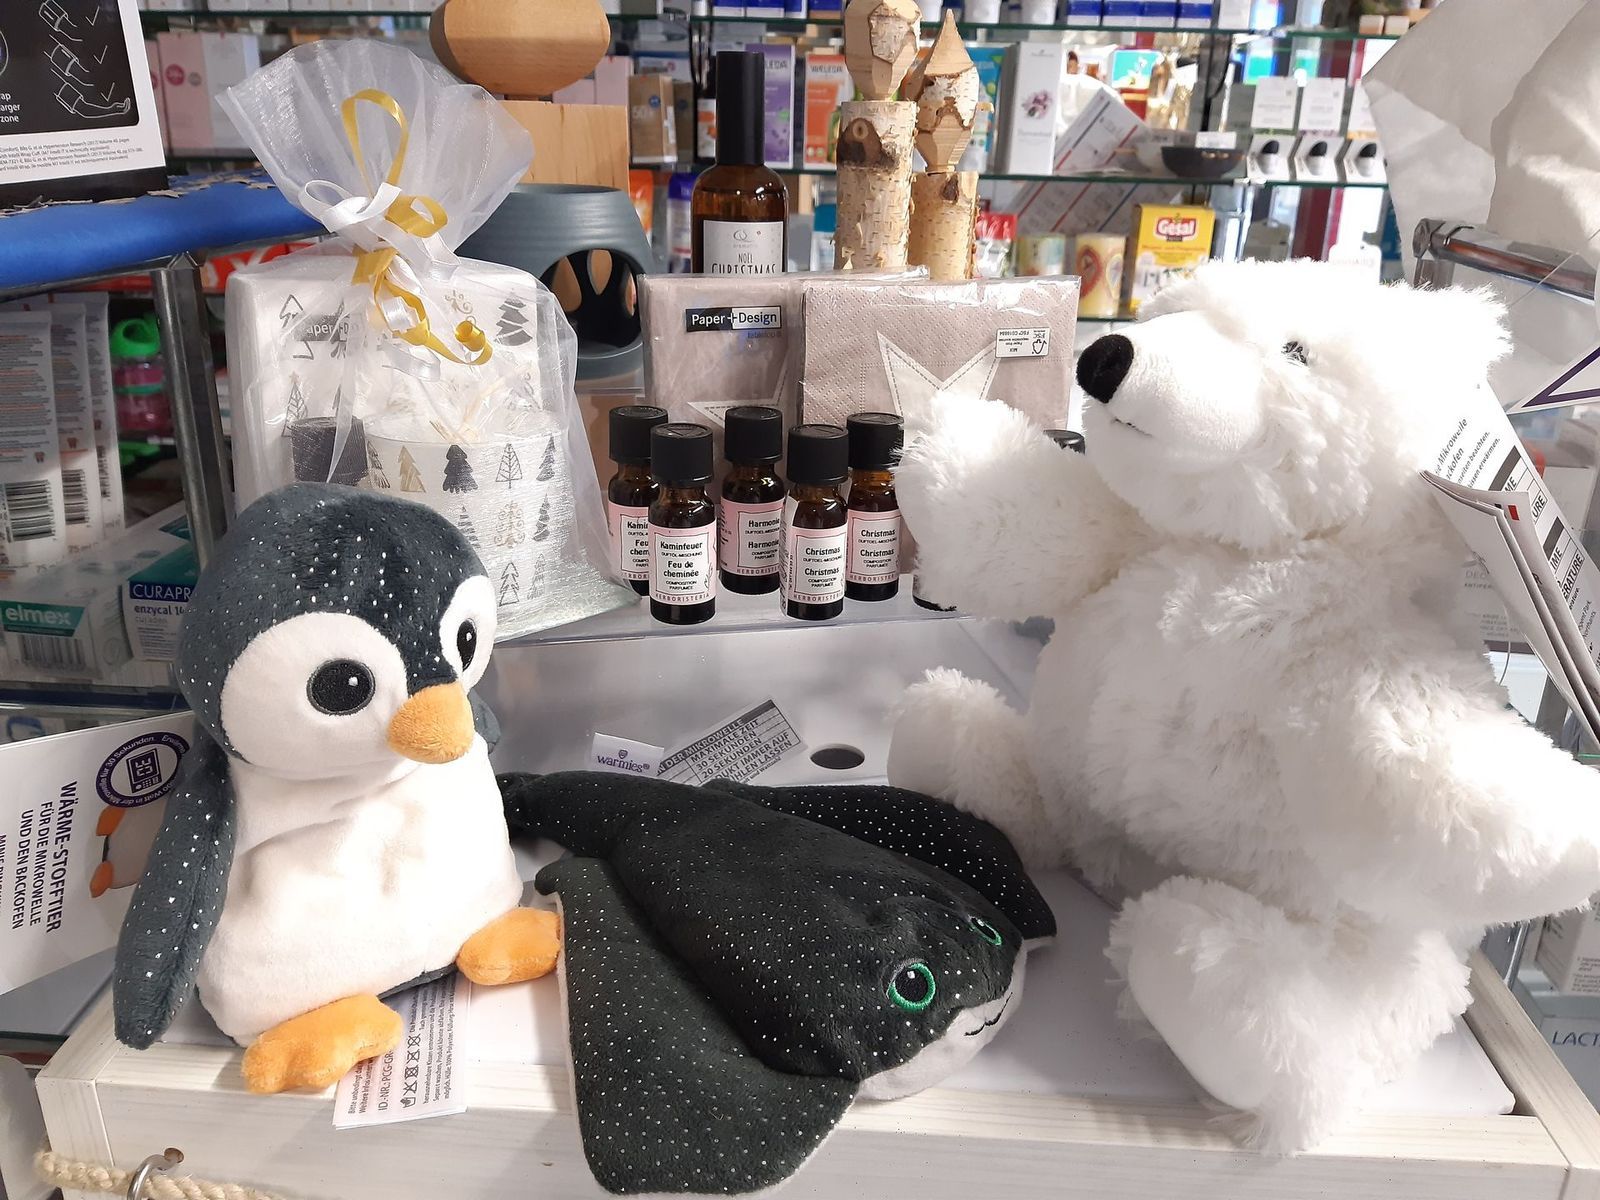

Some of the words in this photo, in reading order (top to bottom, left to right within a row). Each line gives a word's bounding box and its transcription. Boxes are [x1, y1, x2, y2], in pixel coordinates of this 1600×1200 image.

[660, 540, 703, 551] Kaminfeuer
[861, 529, 896, 538] Christmas
[667, 560, 682, 569] Feu
[684, 560, 694, 568] de
[805, 547, 841, 556] Christmas
[860, 548, 895, 557] Christmas
[663, 569, 700, 578] cheminée
[804, 567, 840, 576] Christmas
[132, 583, 192, 600] CURAPR
[5, 604, 72, 626] elmex
[134, 604, 172, 616] enzycal
[105, 757, 117, 768] 30
[113, 736, 155, 759] Sekunden
[664, 751, 685, 768] DER
[684, 717, 743, 757] MIKROWELLE
[690, 730, 739, 764] MAXIMALE
[738, 718, 760, 735] ZEIT
[695, 759, 708, 771] 30
[706, 729, 757, 764] SEKUNDEN
[739, 741, 772, 765] IMMER
[770, 730, 790, 747] AUF
[757, 738, 793, 764] LASSEN
[701, 766, 714, 779] 20
[712, 736, 763, 771] SEKUNDEN
[19, 809, 34, 837] UND
[38, 801, 55, 827] FÜR
[36, 827, 50, 849] DIE
[16, 838, 31, 865] DEN
[46, 780, 80, 934] WÄRME-STOFFTIER
[11, 866, 28, 930] BACKOFEN
[29, 849, 48, 927] MIKROWELLE
[1552, 1030, 1600, 1047] LACT
